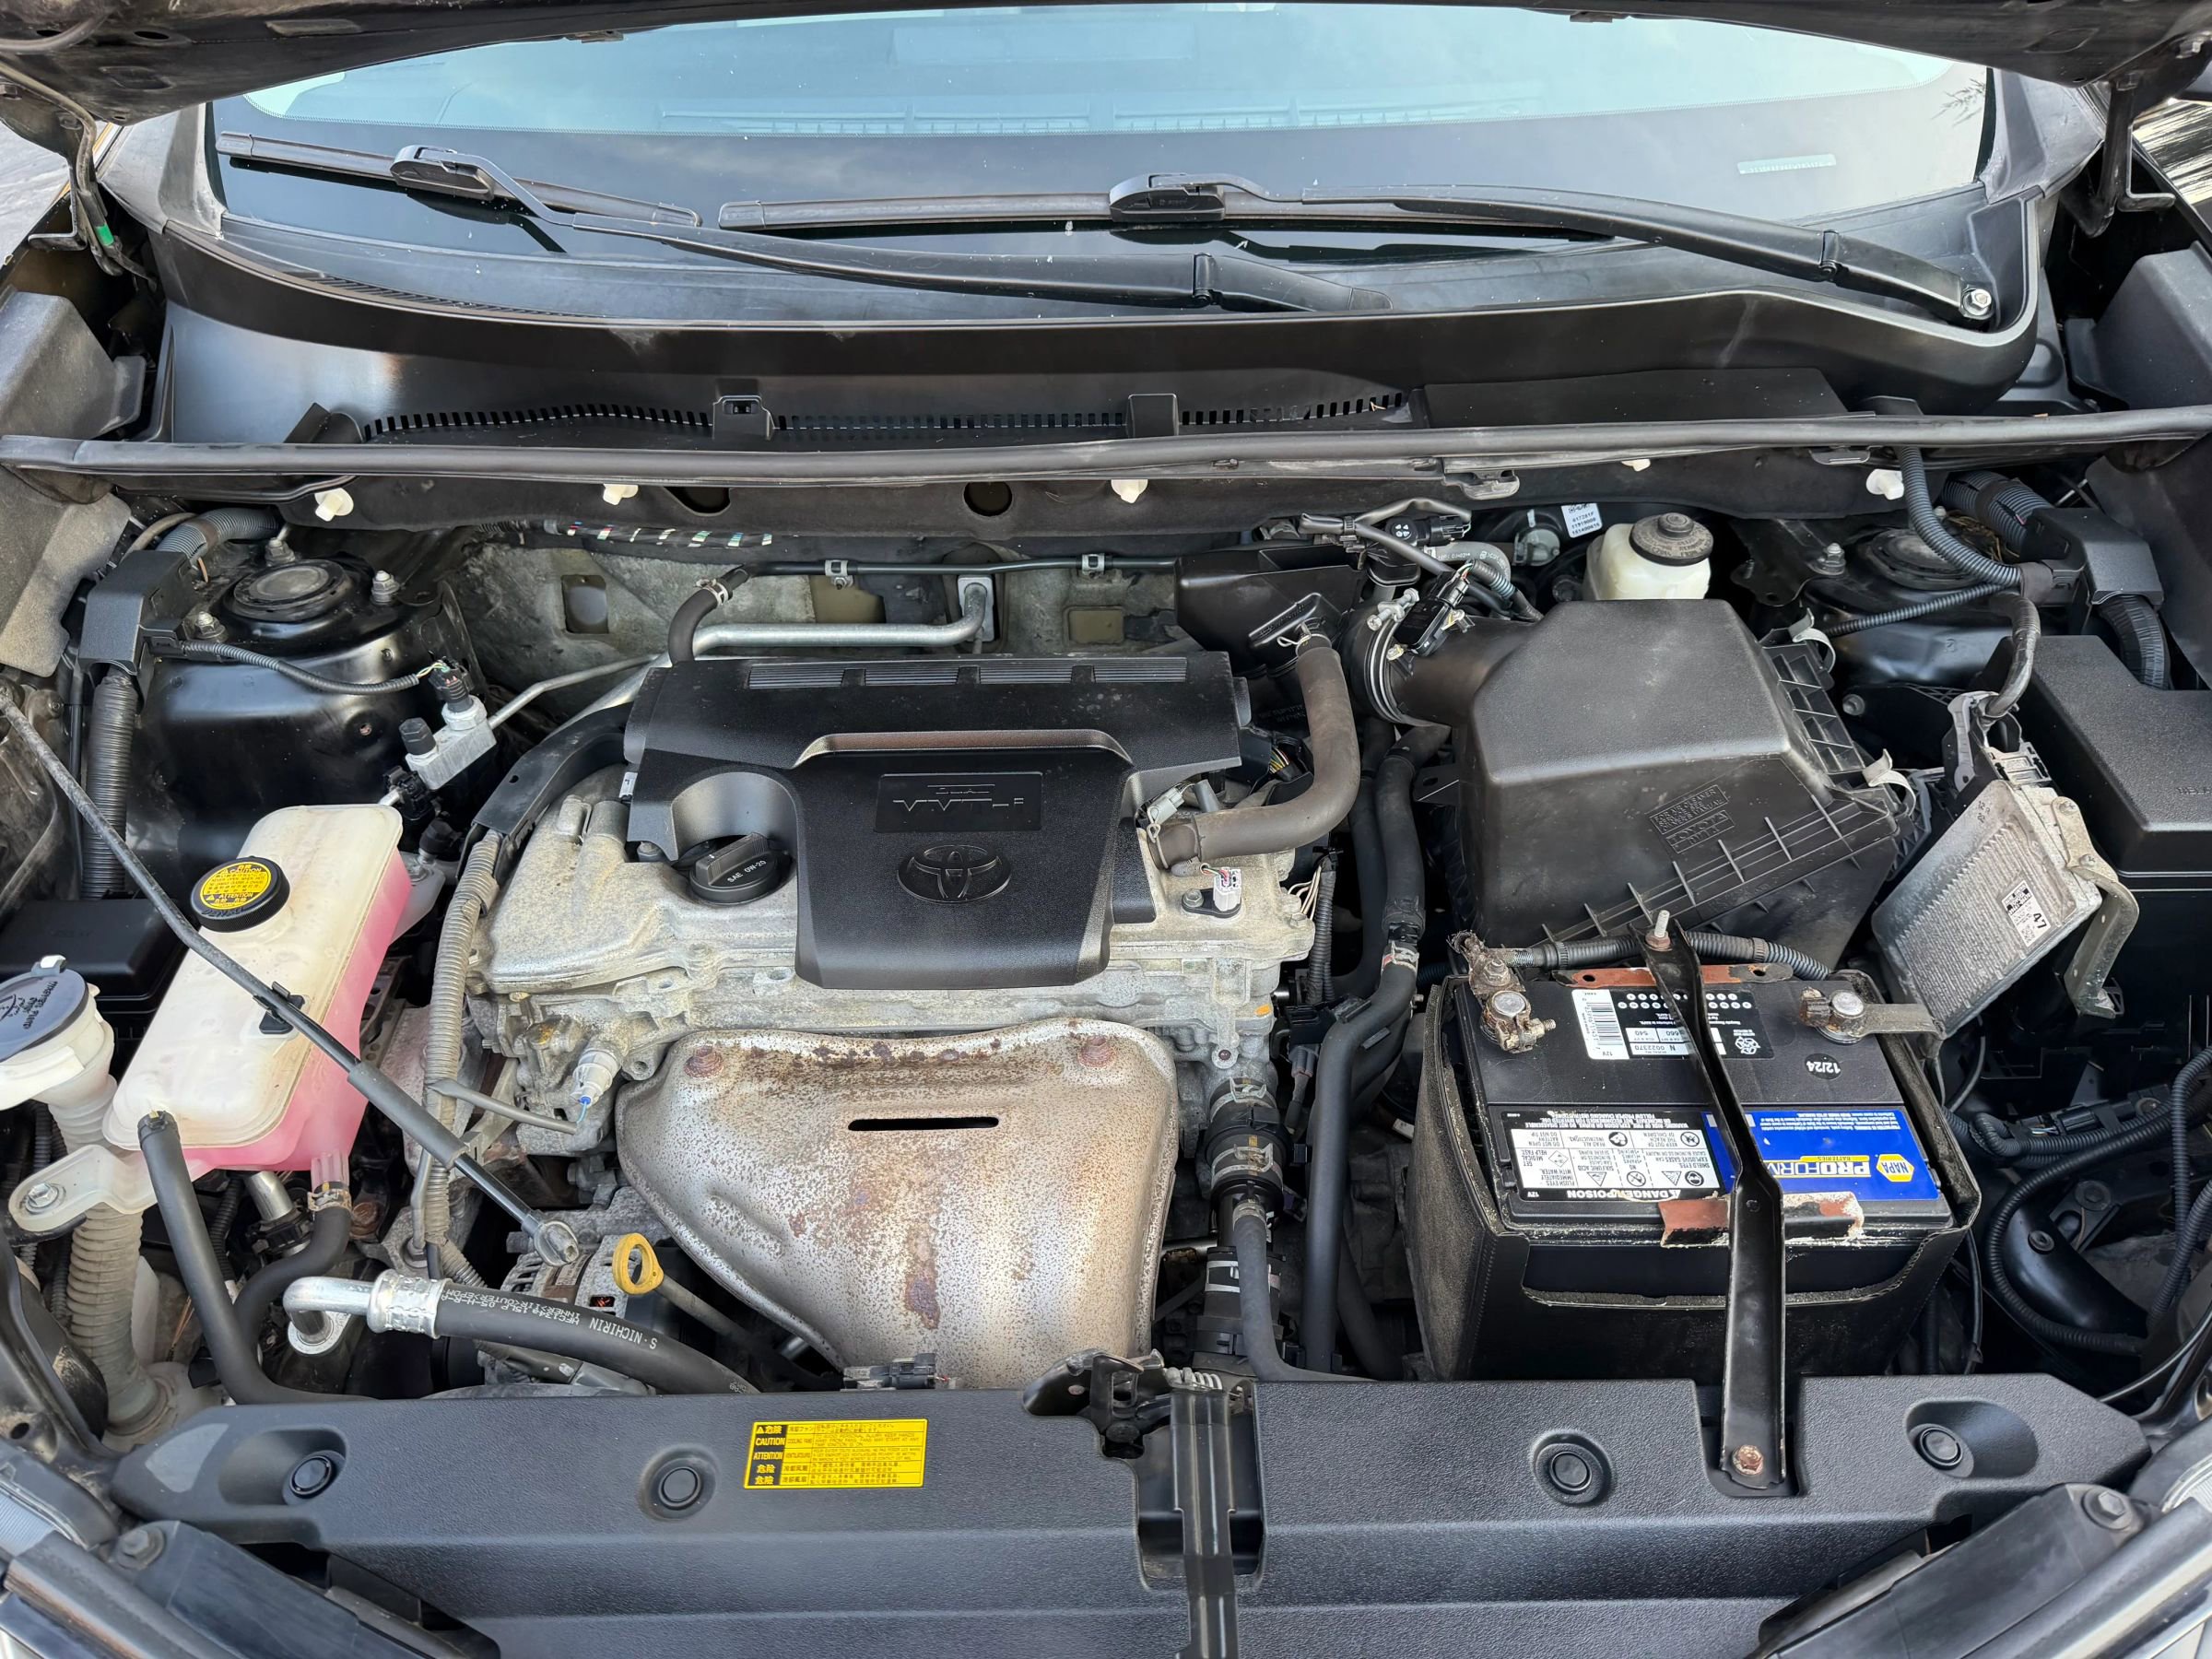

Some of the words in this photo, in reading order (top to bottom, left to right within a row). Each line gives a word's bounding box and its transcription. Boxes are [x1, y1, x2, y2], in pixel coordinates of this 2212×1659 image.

[1668, 812, 1728, 841] TOYOTA
[727, 873, 743, 883] SAE
[744, 860, 766, 872] 0W-20
[1806, 1061, 1841, 1074] 12/24
[1882, 1162, 1909, 1174] NAPA
[532, 1309, 580, 1325] HFC134a
[756, 1437, 785, 1445] CAUTION
